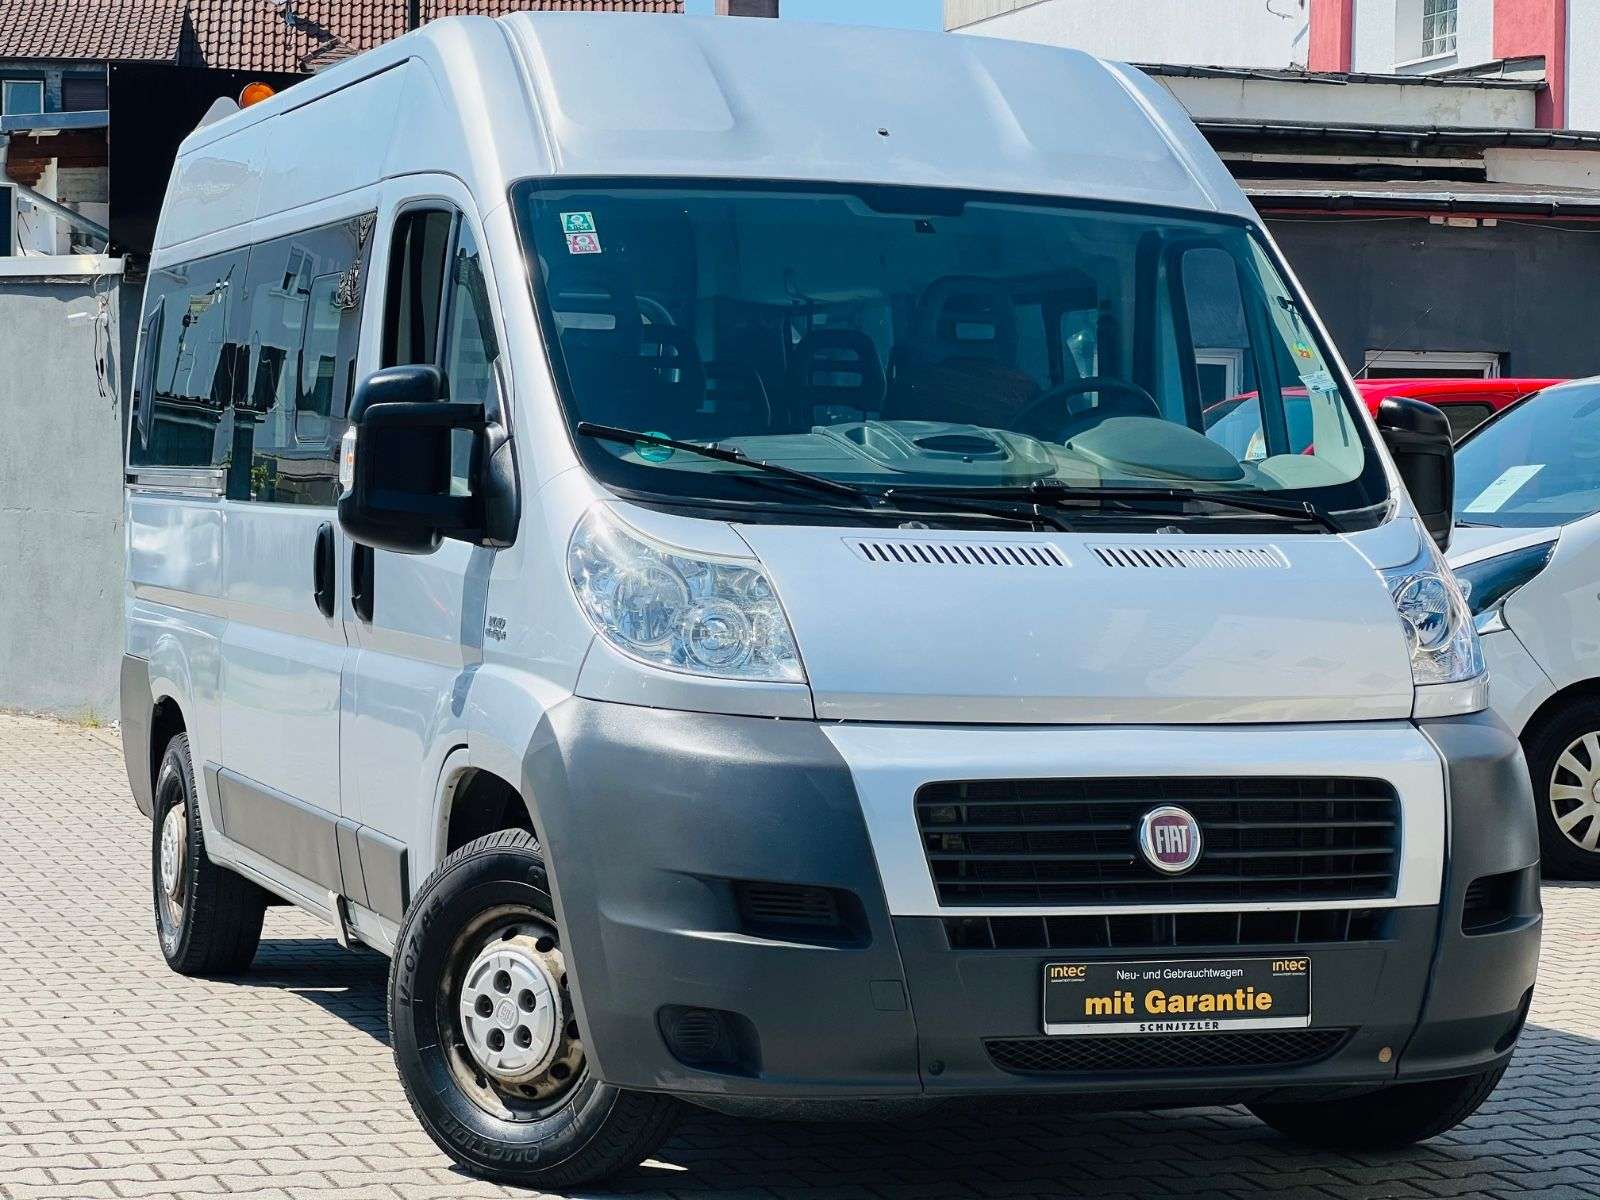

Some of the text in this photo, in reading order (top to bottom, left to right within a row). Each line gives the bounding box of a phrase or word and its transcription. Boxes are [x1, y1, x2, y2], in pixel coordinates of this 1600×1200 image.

[1154, 825, 1188, 854] FIAT
[1272, 960, 1306, 971] intec
[1051, 966, 1087, 978] intec
[1116, 968, 1244, 980] Neu- und Gebrauchtwagen
[1085, 986, 1273, 1015] mit Garantie
[1139, 1021, 1219, 1032] SCHNITZLER
